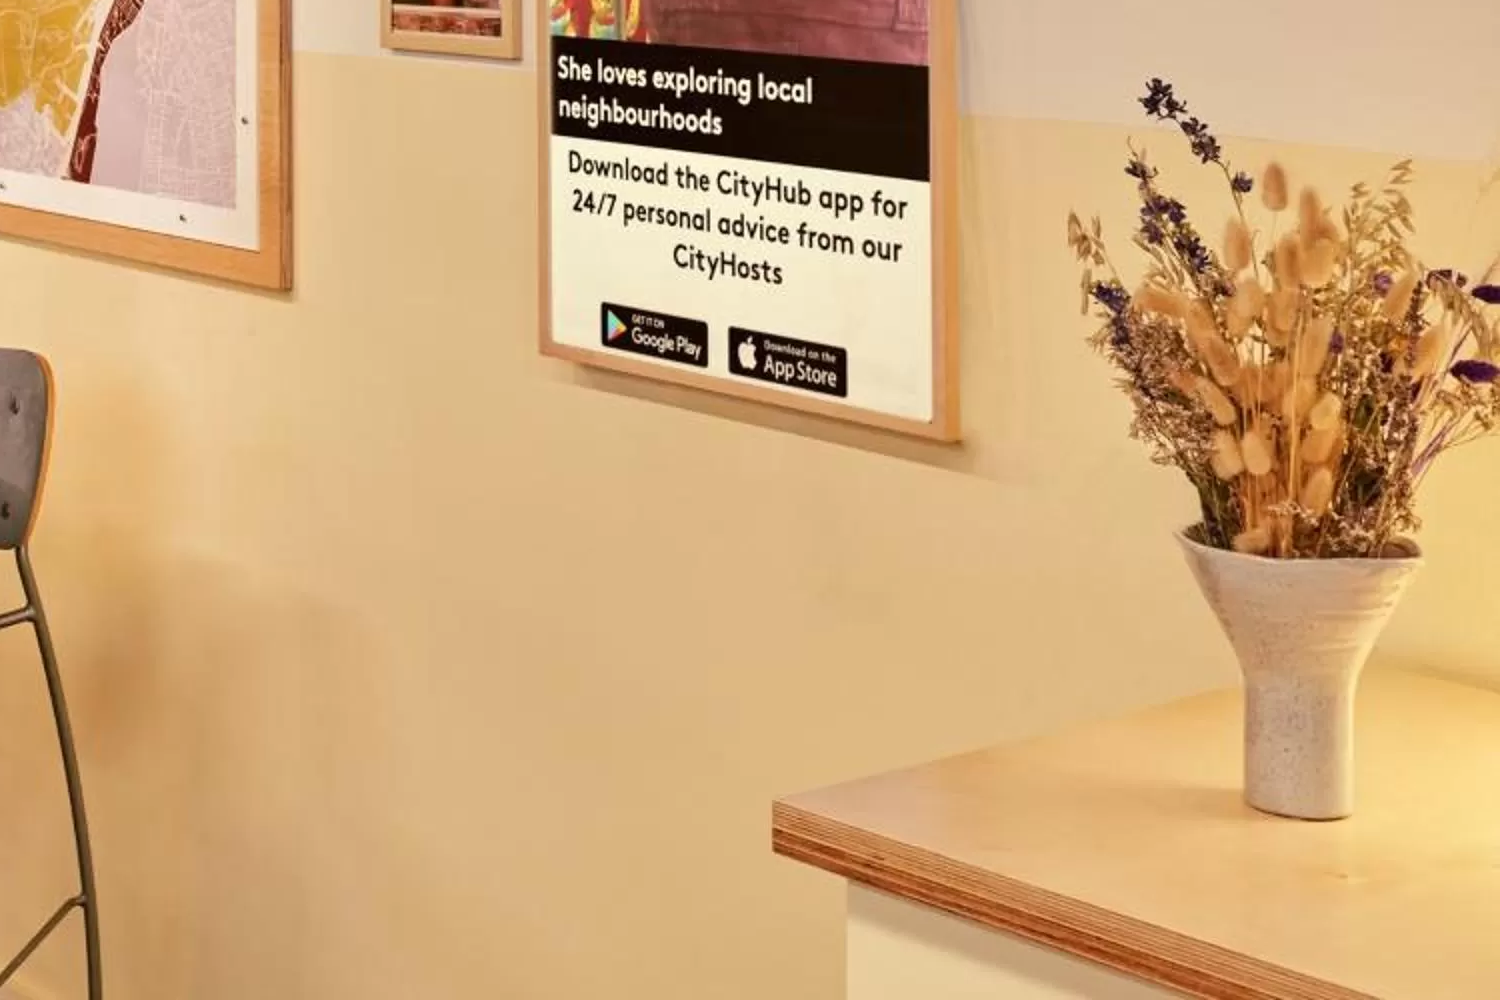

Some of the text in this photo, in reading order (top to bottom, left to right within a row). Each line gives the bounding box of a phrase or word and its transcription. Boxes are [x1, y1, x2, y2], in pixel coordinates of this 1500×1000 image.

[557, 55, 813, 105] She loves exploring local
[558, 94, 723, 135] neighbourhoods
[568, 151, 908, 220] Download the CityHub app for
[573, 190, 903, 262] 24/7 personal advice from our
[673, 245, 783, 284] CityHosts
[631, 314, 665, 329] GET IT ON
[631, 327, 702, 360] Google Play
[764, 340, 837, 363] Download on the
[763, 356, 838, 387] App Store
